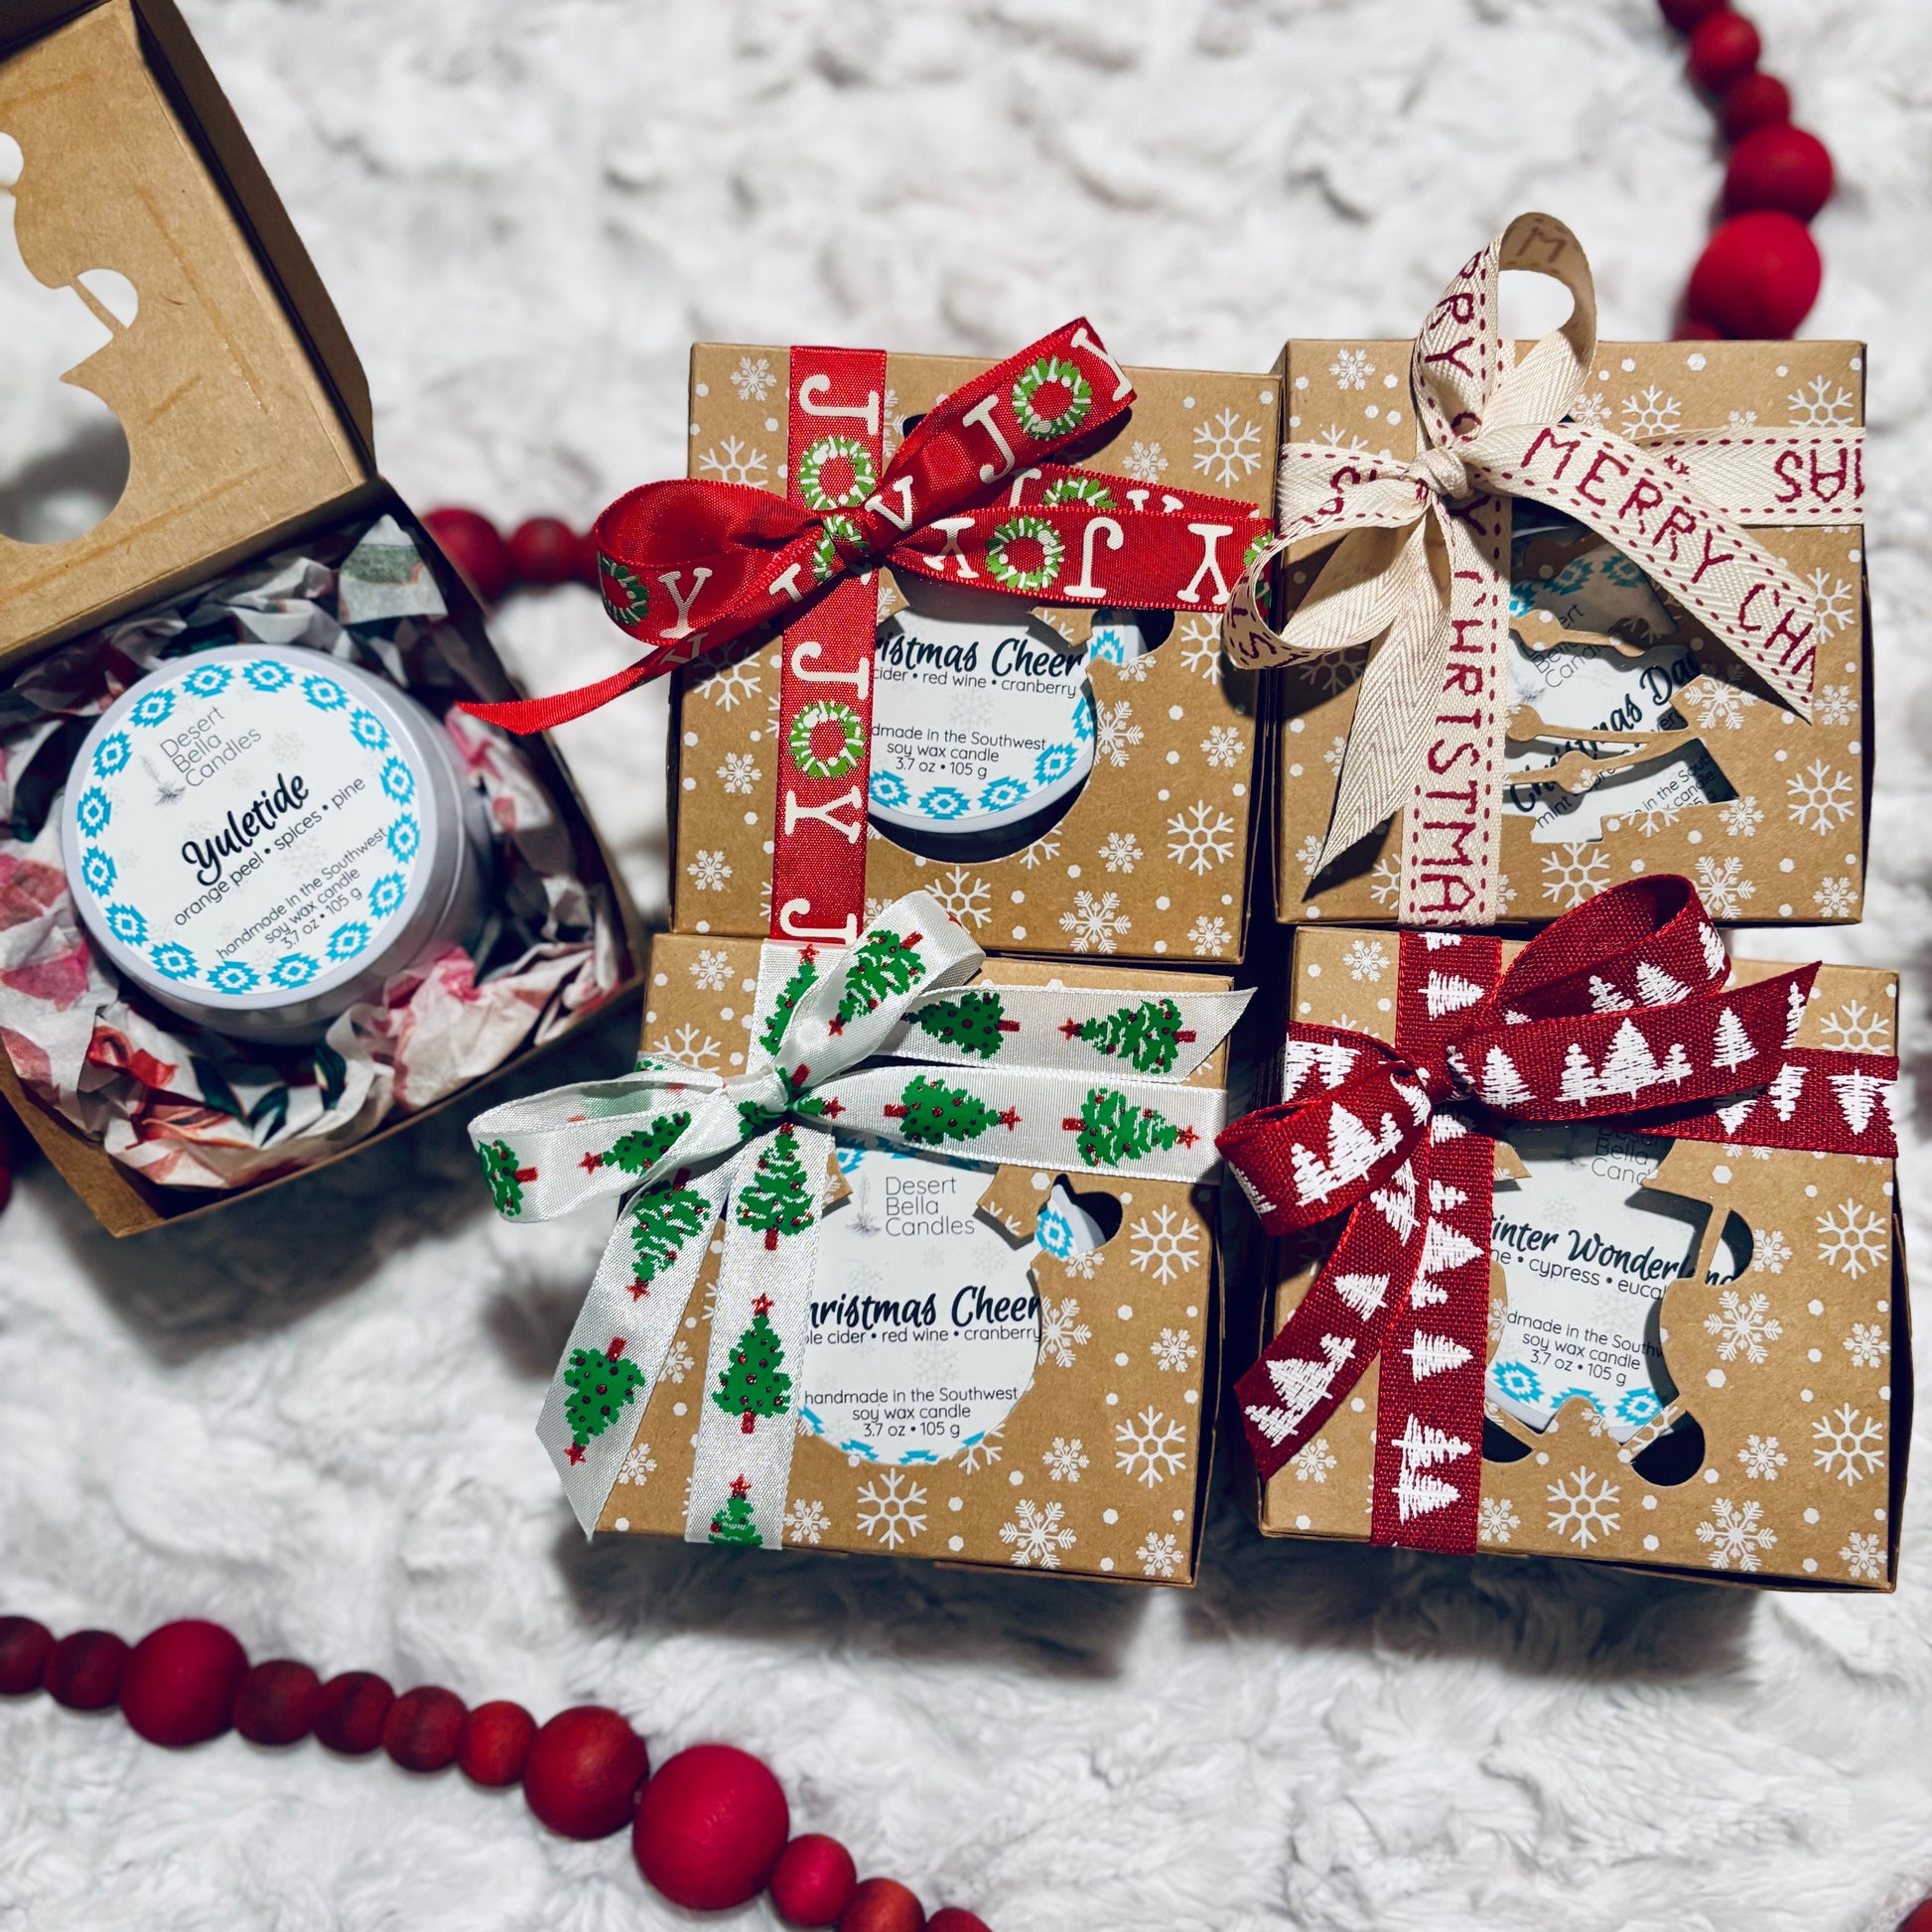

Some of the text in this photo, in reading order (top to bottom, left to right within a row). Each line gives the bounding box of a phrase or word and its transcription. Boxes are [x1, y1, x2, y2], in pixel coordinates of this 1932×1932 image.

[1521, 427, 1735, 584] MERRY
[992, 637, 1085, 677] Cheer
[922, 672, 948, 685] red
[953, 673, 987, 688] wine
[1002, 679, 1076, 699] cranberry
[160, 705, 225, 759] Desert
[785, 640, 871, 844] JOY
[927, 728, 940, 743] in
[944, 730, 967, 745] the
[971, 732, 1045, 751] Southwest
[172, 732, 222, 774] Bella
[186, 728, 262, 787] Candles
[887, 743, 1000, 762] soy wax candle
[896, 758, 988, 779] 3.7 oz 105 g
[1657, 781, 1679, 802] the
[182, 772, 309, 887] Yuletide
[174, 777, 366, 926] orange peel spices pine
[216, 828, 388, 960] handmade in the Southwest
[265, 868, 360, 944] soy wax candle
[281, 888, 363, 950] 3.7 oz 105 g
[1595, 1137, 1649, 1166] Bella
[886, 1175, 956, 1195] Desert
[886, 1196, 938, 1216] Bella
[886, 1216, 975, 1237] Candles
[1491, 1214, 1560, 1253] inter
[1529, 1258, 1600, 1286] cypress
[951, 1285, 1041, 1327] Cheer
[827, 1327, 867, 1344] cider
[883, 1326, 907, 1343] red
[913, 1326, 948, 1341] wine
[964, 1324, 1041, 1343] cranberry
[1507, 1311, 1562, 1334] dmade
[1566, 1323, 1580, 1338] in
[1585, 1326, 1608, 1344] the
[1522, 1332, 1641, 1370] soy wax candle
[1530, 1349, 1627, 1387] 3.7 oz 105 g
[804, 1386, 1018, 1405] handmade in the Southwest
[852, 1404, 971, 1423] soy wax candle
[864, 1422, 960, 1438] 3.7 oz 105 g
